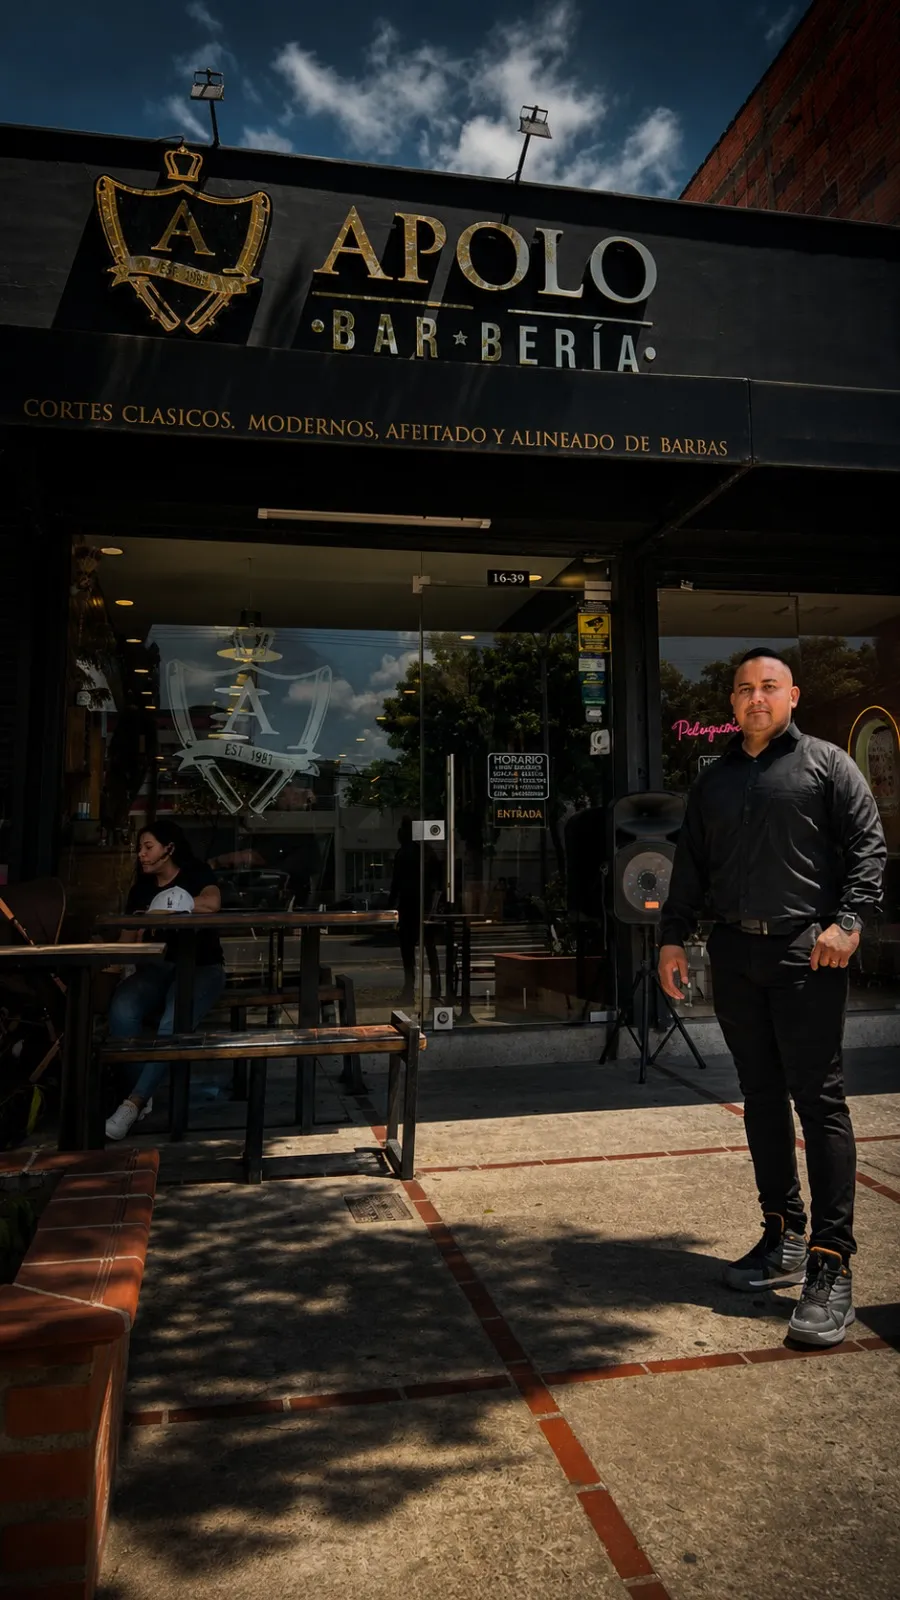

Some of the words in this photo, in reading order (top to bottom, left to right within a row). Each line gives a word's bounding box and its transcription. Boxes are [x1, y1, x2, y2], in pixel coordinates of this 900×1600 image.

[313, 205, 657, 304] APOLO
[333, 309, 438, 358] BAR
[481, 322, 640, 373] BERÍA
[23, 398, 113, 422] CORTES
[121, 405, 235, 430] CLASICOS.
[247, 413, 380, 440] MODERNOS,
[385, 423, 487, 444] AFEITADO
[492, 428, 506, 445] Y
[511, 430, 615, 451] ALINEADO
[624, 435, 650, 452] DE
[660, 437, 728, 457] BARBAS
[493, 572, 525, 584] 16-39
[250, 750, 274, 766] 1987
[493, 755, 543, 765] HORARIO
[497, 809, 543, 819] ENTRADA
